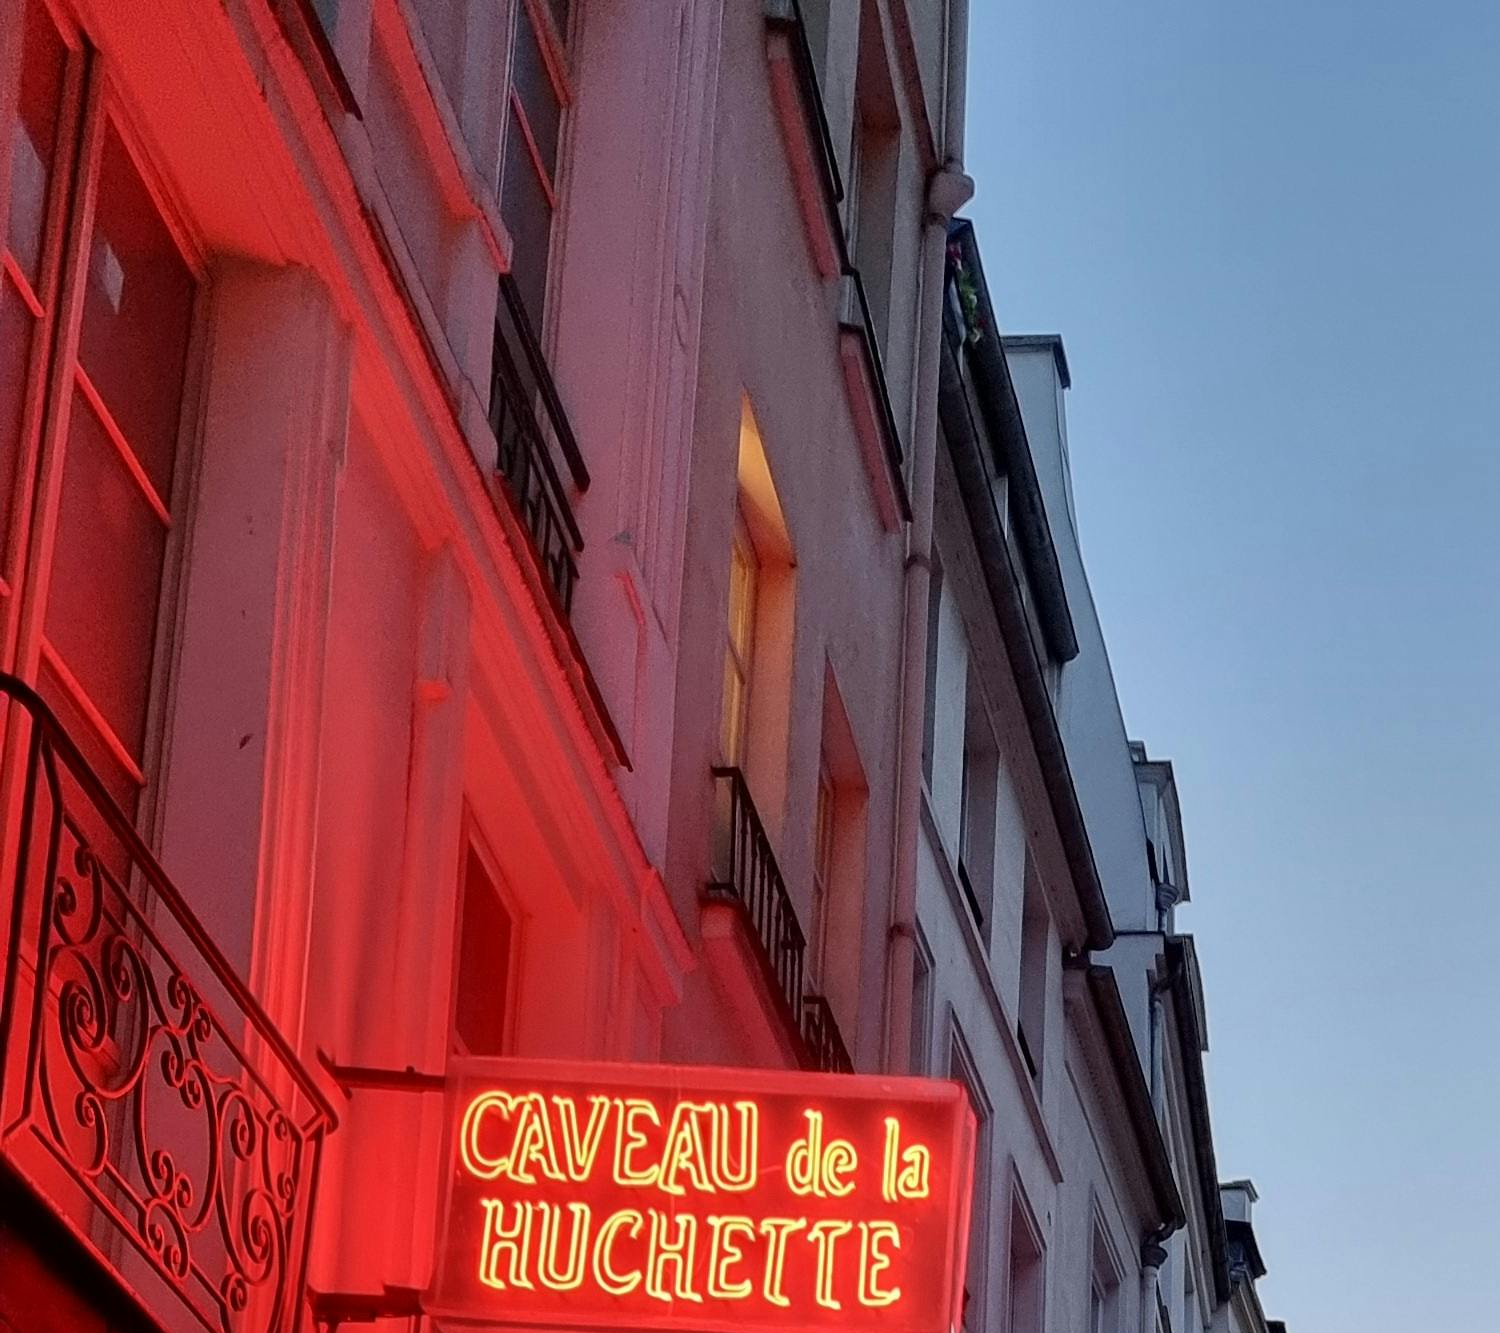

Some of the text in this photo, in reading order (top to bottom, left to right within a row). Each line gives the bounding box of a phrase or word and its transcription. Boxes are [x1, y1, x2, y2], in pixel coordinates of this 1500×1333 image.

[460, 1089, 930, 1203] CAVEAU de la
[478, 1197, 902, 1310] HUCHETTE
